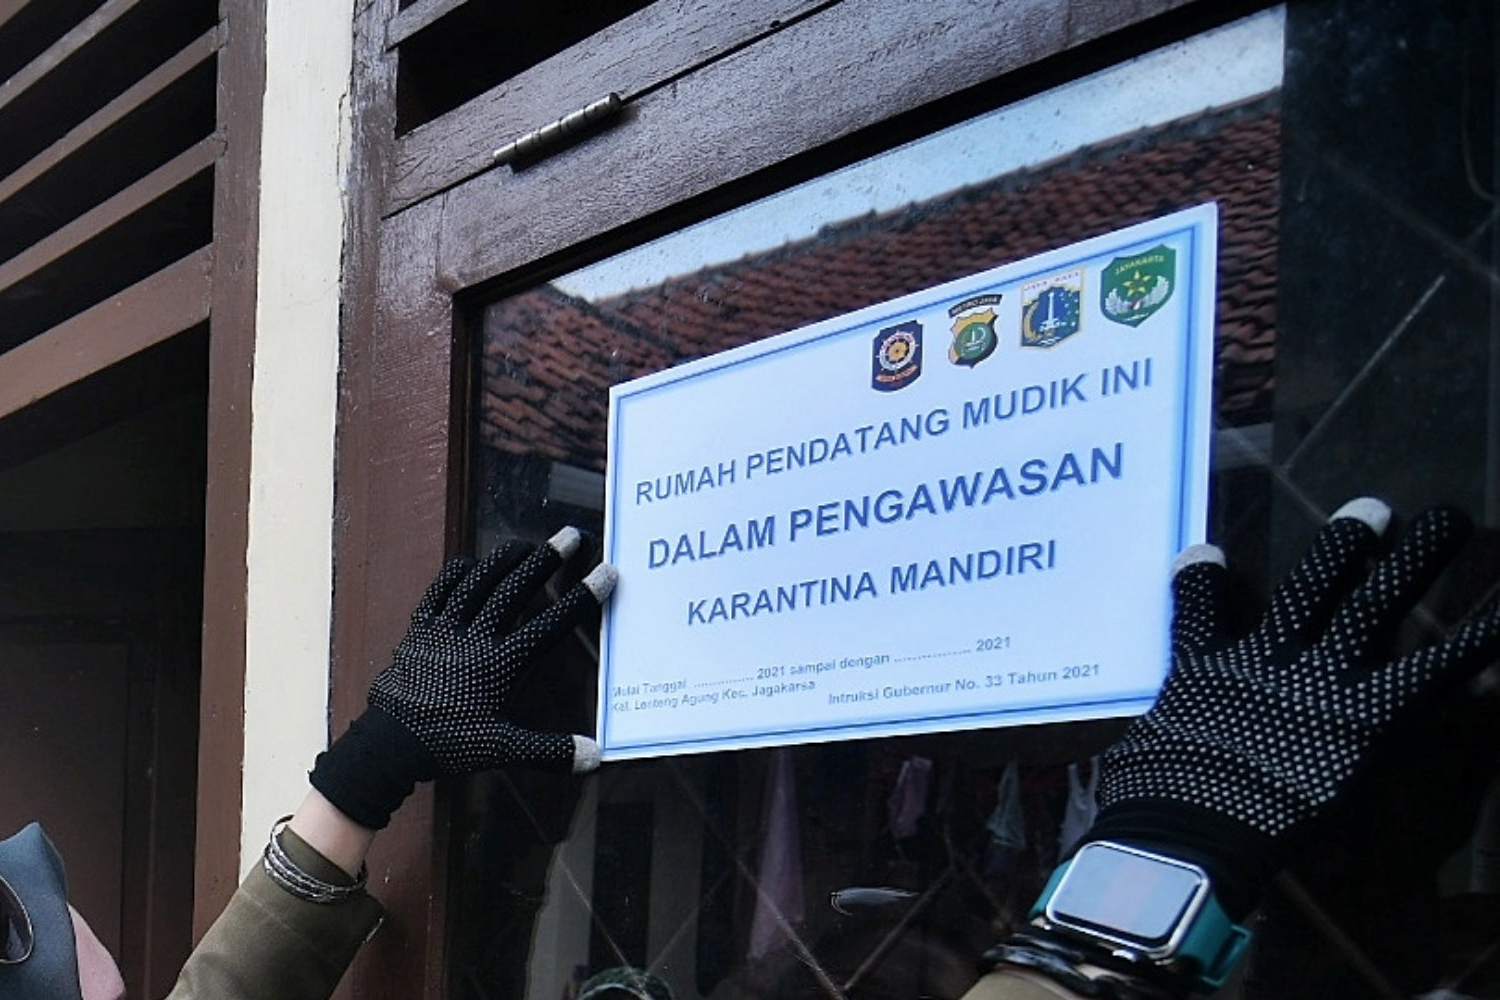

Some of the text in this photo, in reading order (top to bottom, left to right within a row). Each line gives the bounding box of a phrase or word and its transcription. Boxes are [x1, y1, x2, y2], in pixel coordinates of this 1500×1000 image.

[636, 357, 1152, 505] RUMAH PENDATANG MUDIK INI
[648, 442, 1123, 569] DALAM PENGAWASAN
[687, 539, 1056, 626] KARANTINA MANDIRI
[635, 696, 679, 711] Lenteng
[681, 691, 719, 707] Agung
[752, 681, 816, 698] Jagakarsa
[643, 679, 687, 694] Tanggal
[757, 665, 786, 680] 2021
[790, 659, 836, 677] sampai
[839, 652, 890, 671] dengan
[976, 636, 1012, 652] 2021
[883, 681, 951, 700] Gubernur
[955, 678, 979, 692] No.
[985, 674, 1002, 689] 33
[1007, 669, 1057, 685] Tahun
[1062, 663, 1100, 680] 2021
